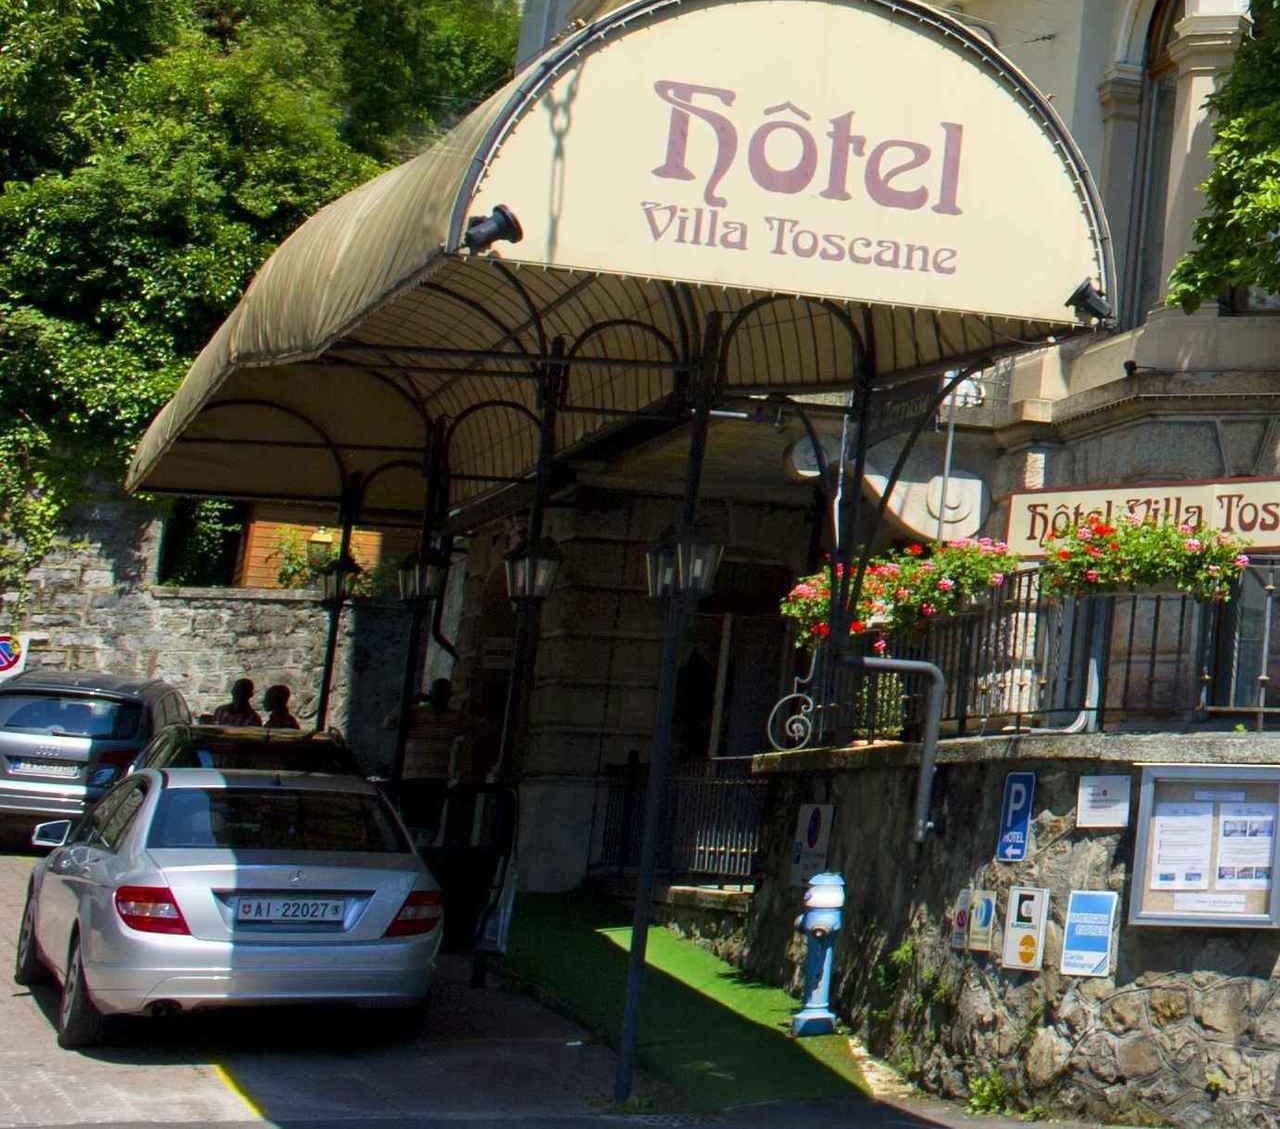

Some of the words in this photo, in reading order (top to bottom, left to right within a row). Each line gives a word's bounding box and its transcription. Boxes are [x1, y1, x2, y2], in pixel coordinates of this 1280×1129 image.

[651, 80, 963, 216] Hôtel
[641, 201, 749, 250] Villa
[764, 216, 958, 275] Toscane
[1007, 783, 1027, 828] P
